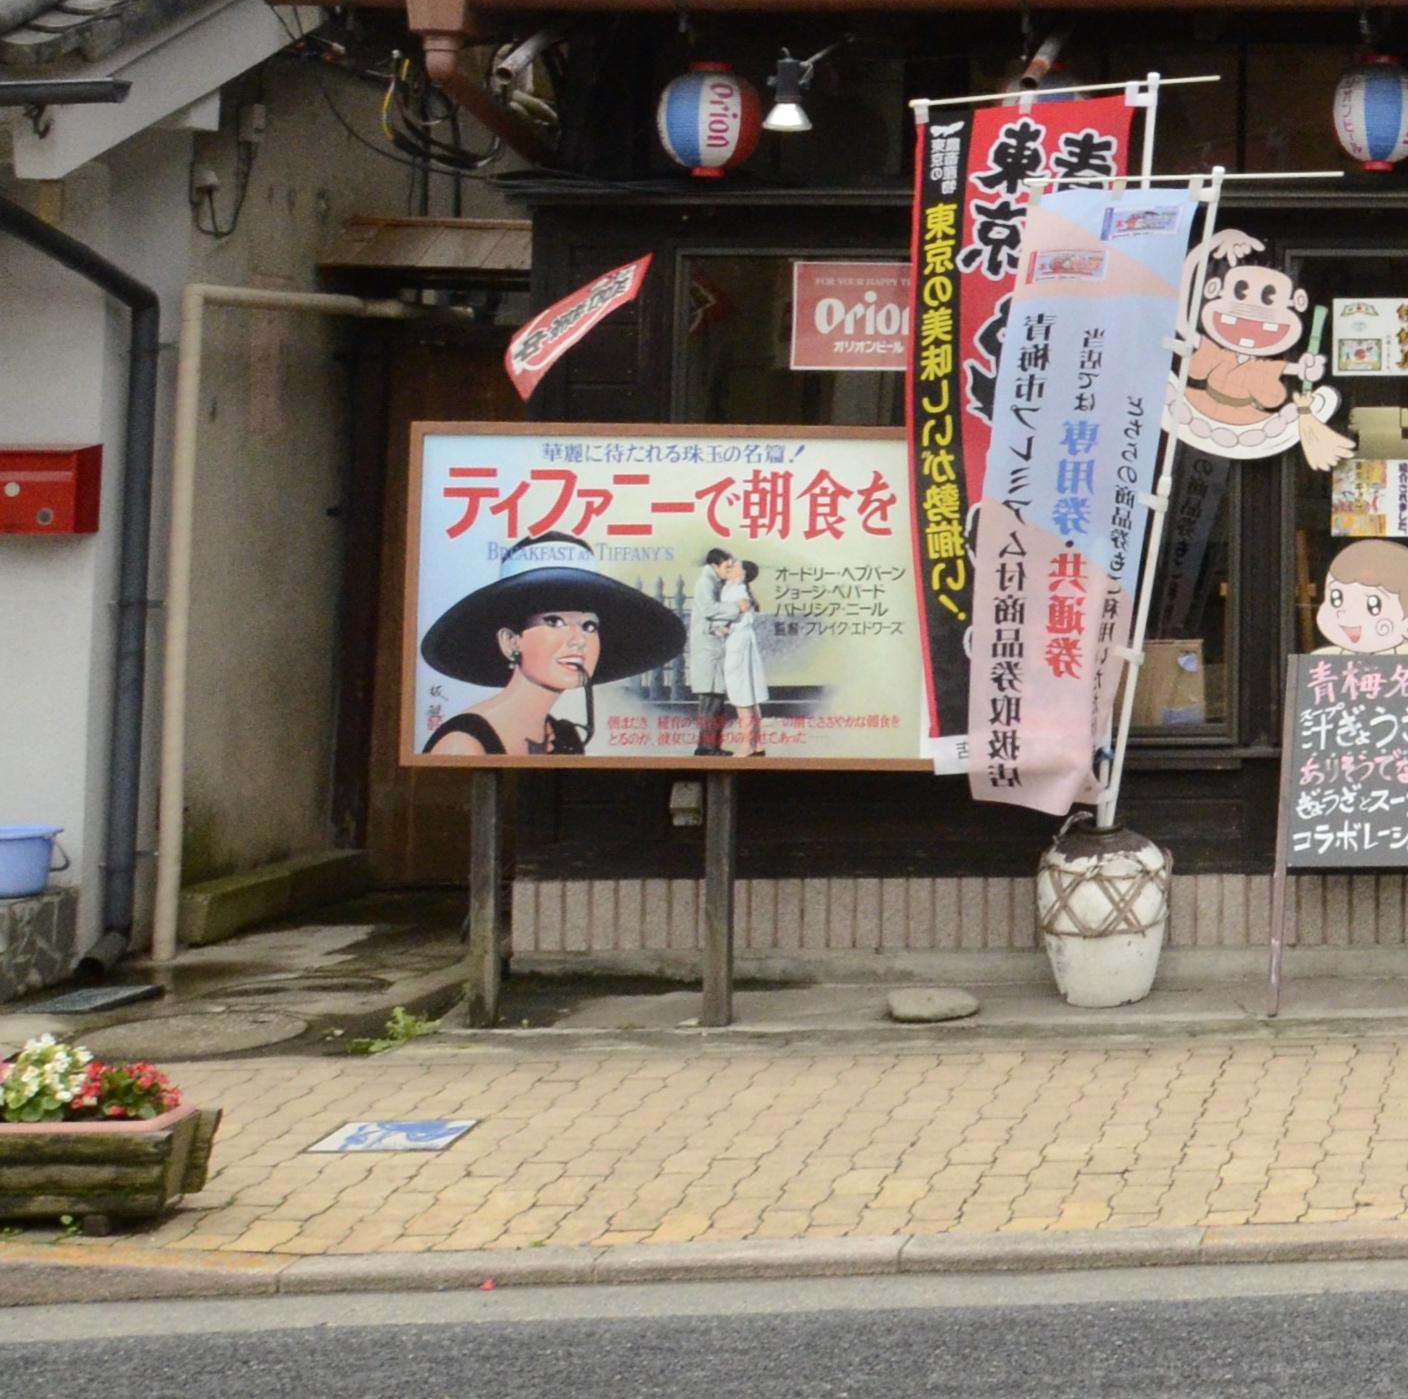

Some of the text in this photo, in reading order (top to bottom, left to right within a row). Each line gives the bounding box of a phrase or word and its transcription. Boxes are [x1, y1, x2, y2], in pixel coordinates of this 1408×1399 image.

[706, 83, 739, 148] Orion
[833, 341, 905, 354] オリオンビール
[442, 465, 899, 541] ティファニーで朝食を
[487, 541, 575, 561] BREAKFAST
[595, 542, 676, 561] TIFFANY'S
[1300, 702, 1345, 722] スープ
